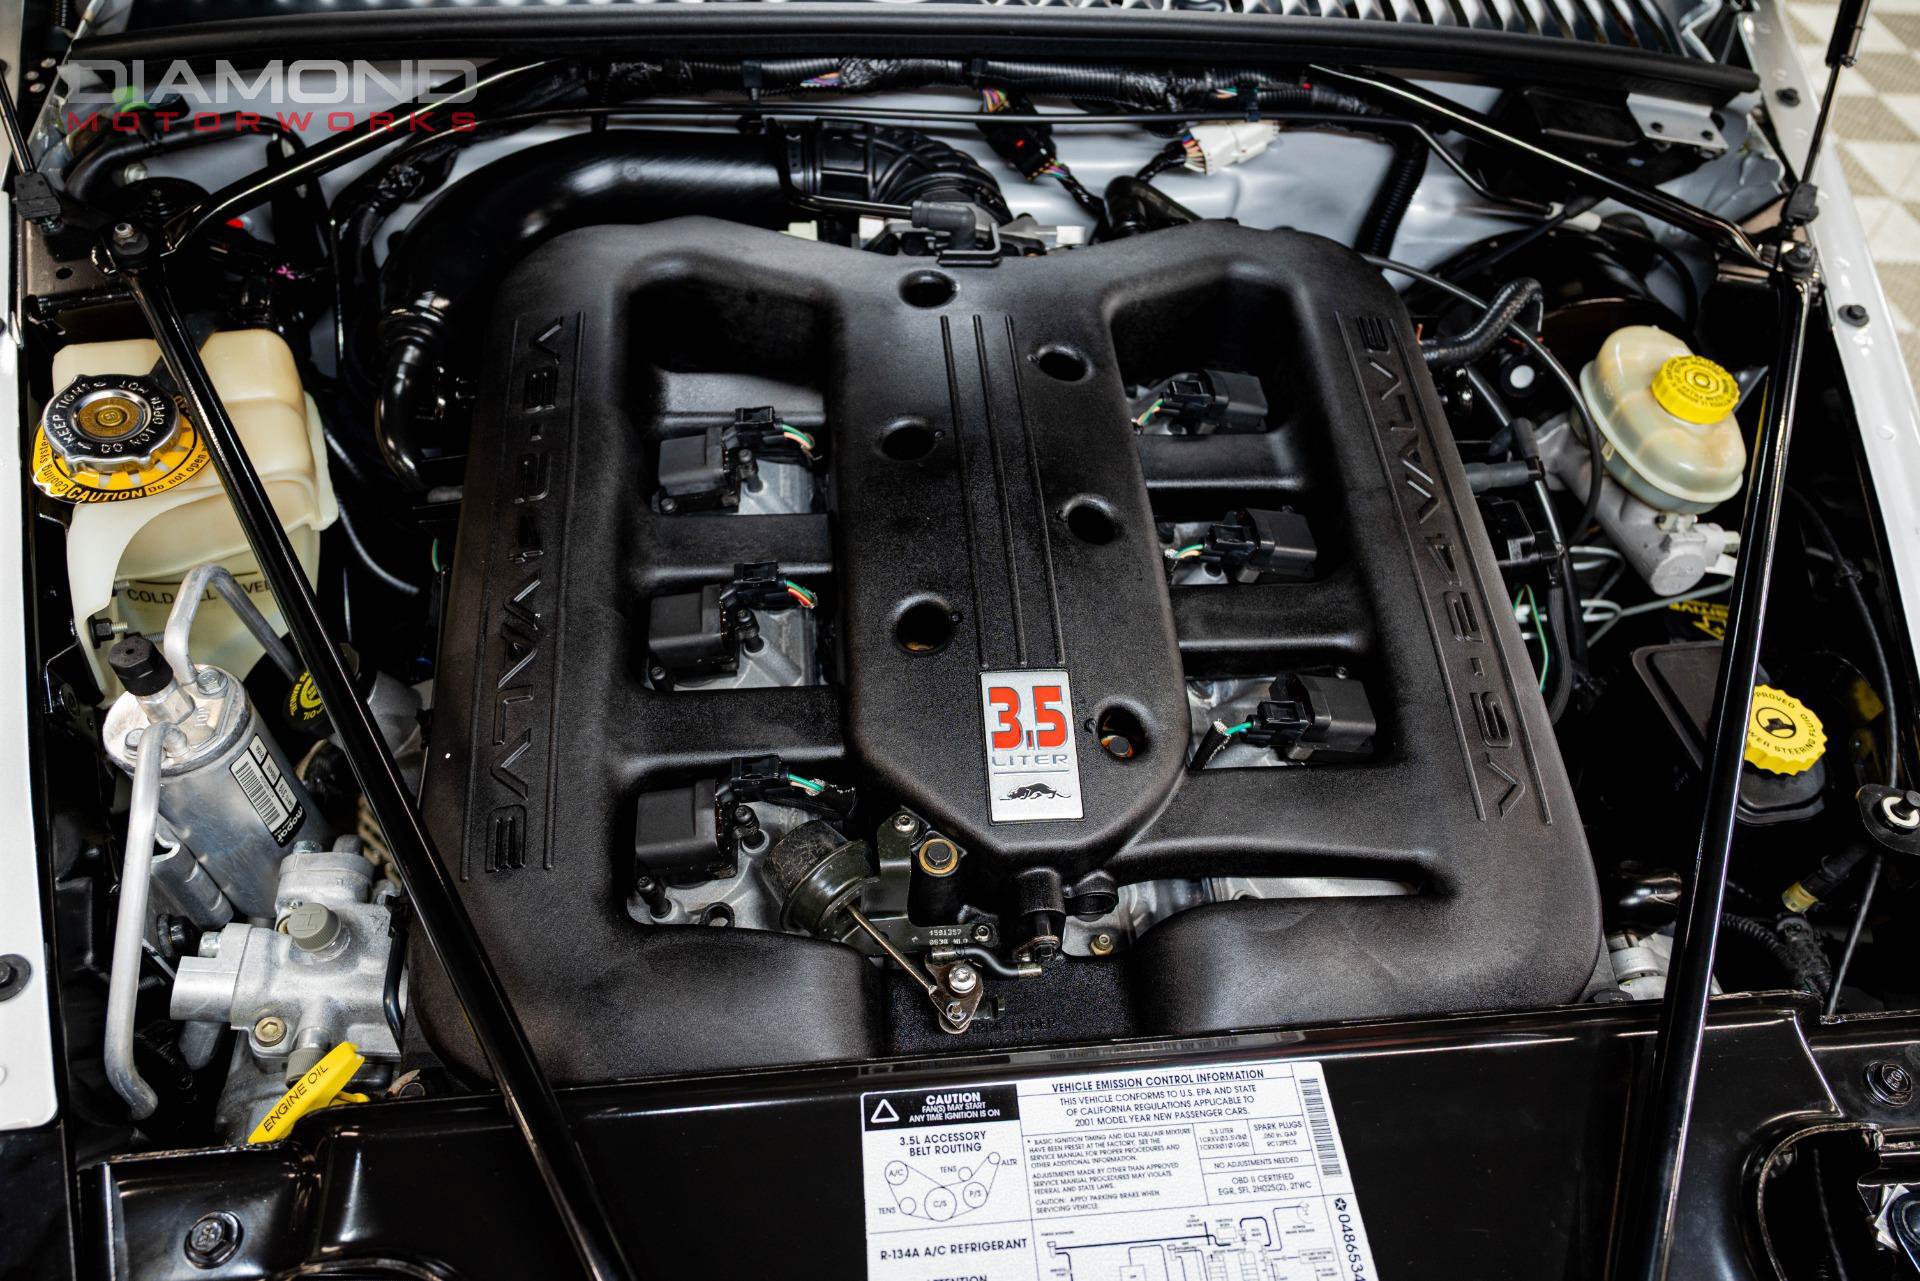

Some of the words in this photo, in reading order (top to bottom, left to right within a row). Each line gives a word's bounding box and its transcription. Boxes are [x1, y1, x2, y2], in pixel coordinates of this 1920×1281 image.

[52, 414, 77, 444] KEEP
[100, 443, 124, 454] DO
[148, 483, 164, 493] Do
[168, 472, 187, 485] not
[186, 454, 207, 472] open
[68, 487, 143, 502] CAUTION
[127, 588, 176, 604] COLD
[988, 686, 1068, 750] 3.5
[991, 754, 1068, 768] LITER
[277, 806, 304, 843] mopar
[1052, 1081, 1092, 1092] VEHICLE
[1096, 1078, 1142, 1089] EMISSION
[1146, 1074, 1194, 1086] CONTROL
[1196, 1069, 1264, 1082] INFORMATION
[262, 1083, 308, 1132] ENGINE
[307, 1064, 329, 1085] OIL
[926, 1092, 981, 1105] CAUTION
[1060, 1098, 1077, 1106] THIS
[1079, 1095, 1113, 1104] VEHICLE
[1116, 1091, 1165, 1102] CONFORMS
[1234, 1084, 1256, 1093] STATE
[922, 1105, 945, 1114] FAN(S)
[947, 1103, 964, 1111] MAY
[964, 1102, 986, 1110] START
[1081, 1105, 1131, 1115] CALIFORNIA
[1134, 1100, 1191, 1111] REGULATIONS
[1194, 1096, 1241, 1107] APPLICABLE
[909, 1115, 925, 1123] ANY
[945, 1111, 978, 1120] IGNITION
[1075, 1118, 1095, 1127] 2001
[1097, 1116, 1127, 1125] MODEL
[1129, 1114, 1152, 1123] YEAR
[1175, 1108, 1223, 1119] PASSENGER
[1225, 1107, 1249, 1115] CARS.
[1253, 1122, 1276, 1132] SPARK
[900, 1136, 921, 1146] 3.5L
[924, 1130, 986, 1144] ACCESSORY
[909, 1147, 930, 1157] BELT
[935, 1142, 982, 1154] ROUTING
[1146, 1162, 1179, 1170] APPROVED
[1227, 1158, 1272, 1167] ADJUSTMENTS
[889, 1169, 904, 1177] A/C
[1257, 1173, 1294, 1182] CERTIFIED
[1290, 1181, 1312, 1190] 2TWC
[880, 1248, 920, 1260] R-134A
[924, 1245, 946, 1257] A/C
[950, 1238, 1027, 1254] REFRIGERANT
